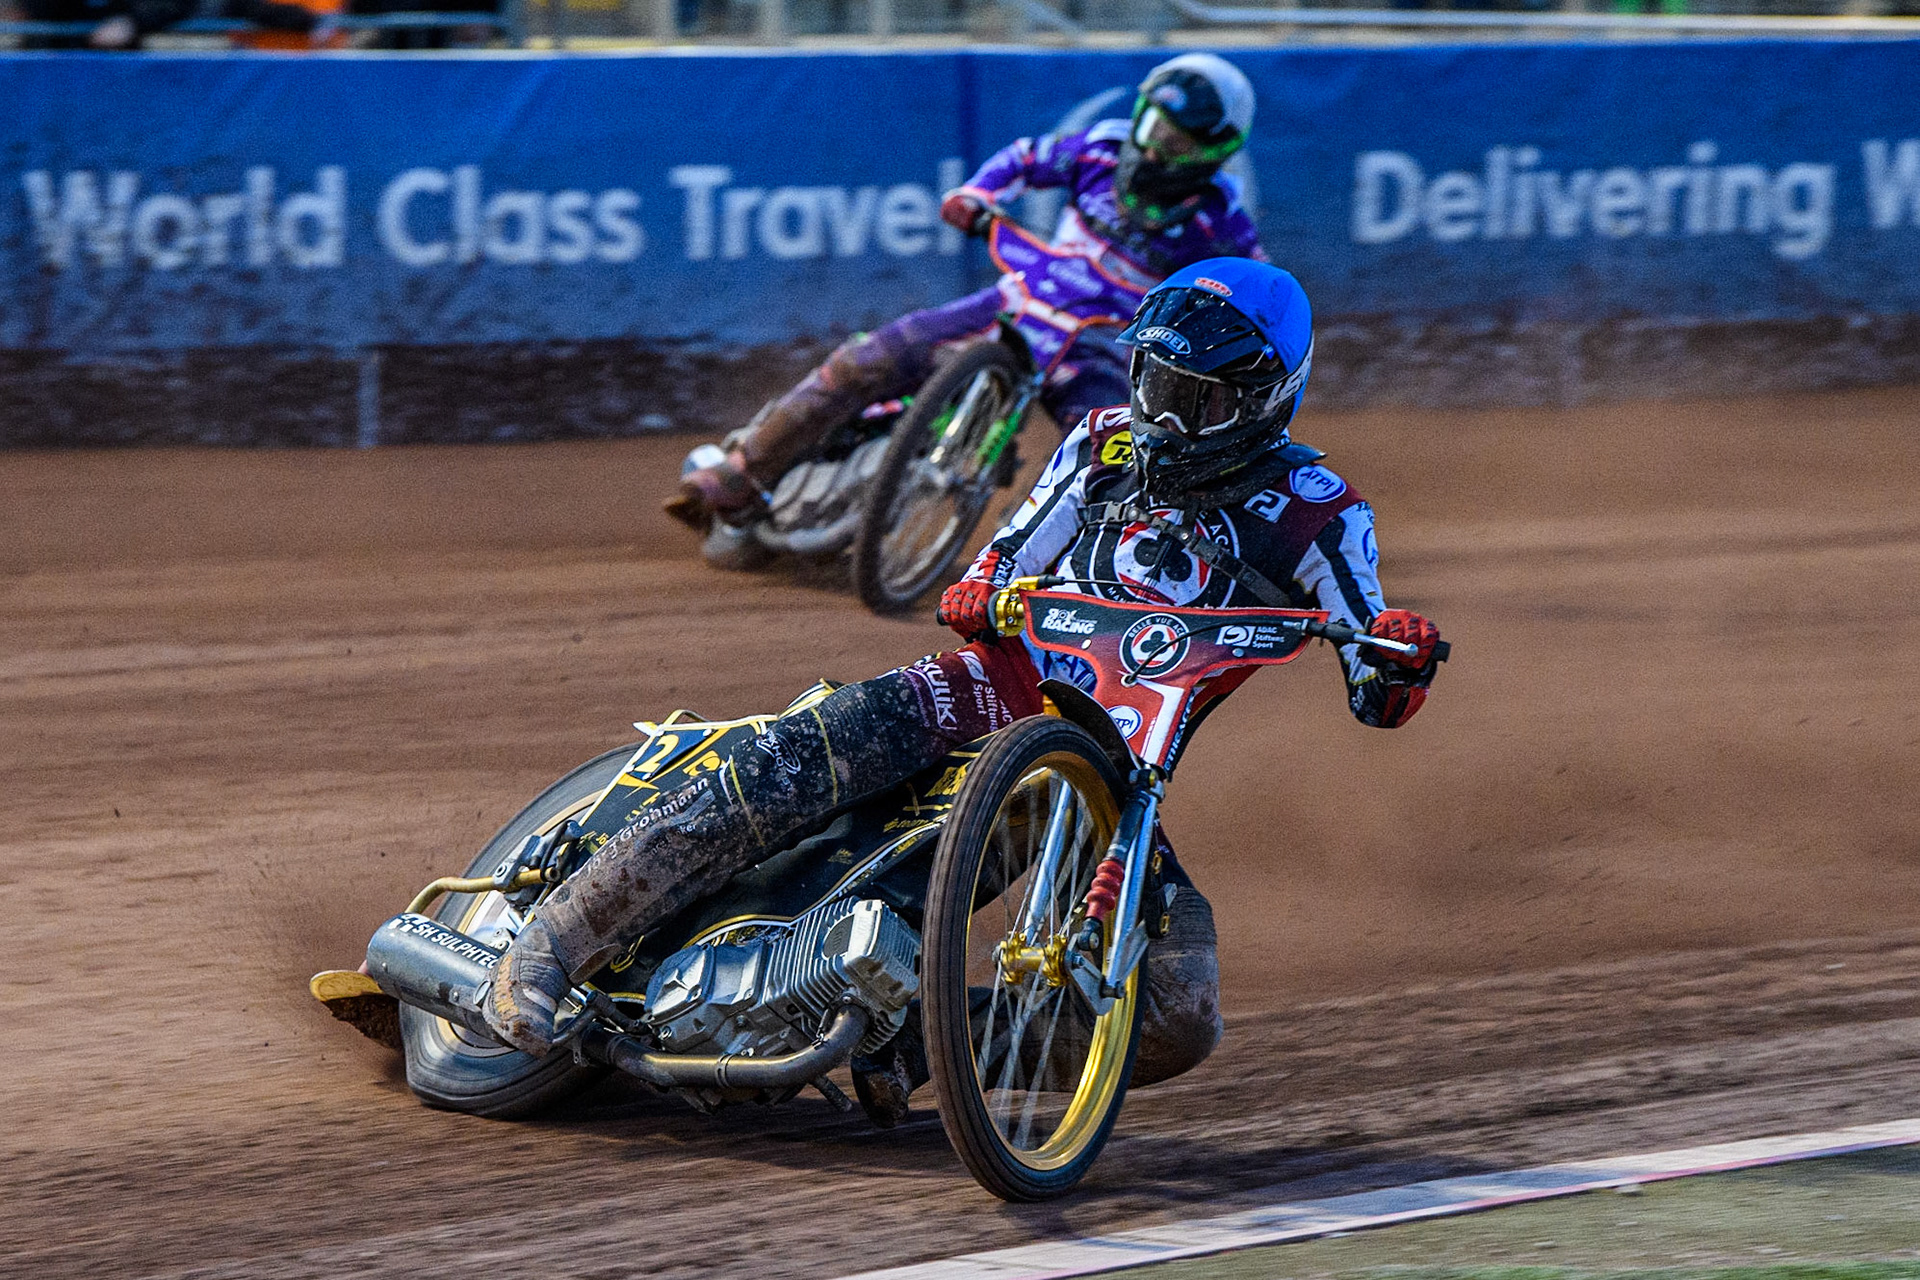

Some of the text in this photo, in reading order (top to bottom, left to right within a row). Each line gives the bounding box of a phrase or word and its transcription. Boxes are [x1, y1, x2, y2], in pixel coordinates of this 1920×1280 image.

[21, 157, 966, 269] World Class Travel
[1352, 141, 1836, 258] Delivering
[1142, 328, 1187, 351] SHOEI
[1041, 615, 1096, 635] RACING
[1128, 618, 1153, 639] BELLE
[1155, 617, 1173, 626] VUE
[633, 733, 680, 774] 2
